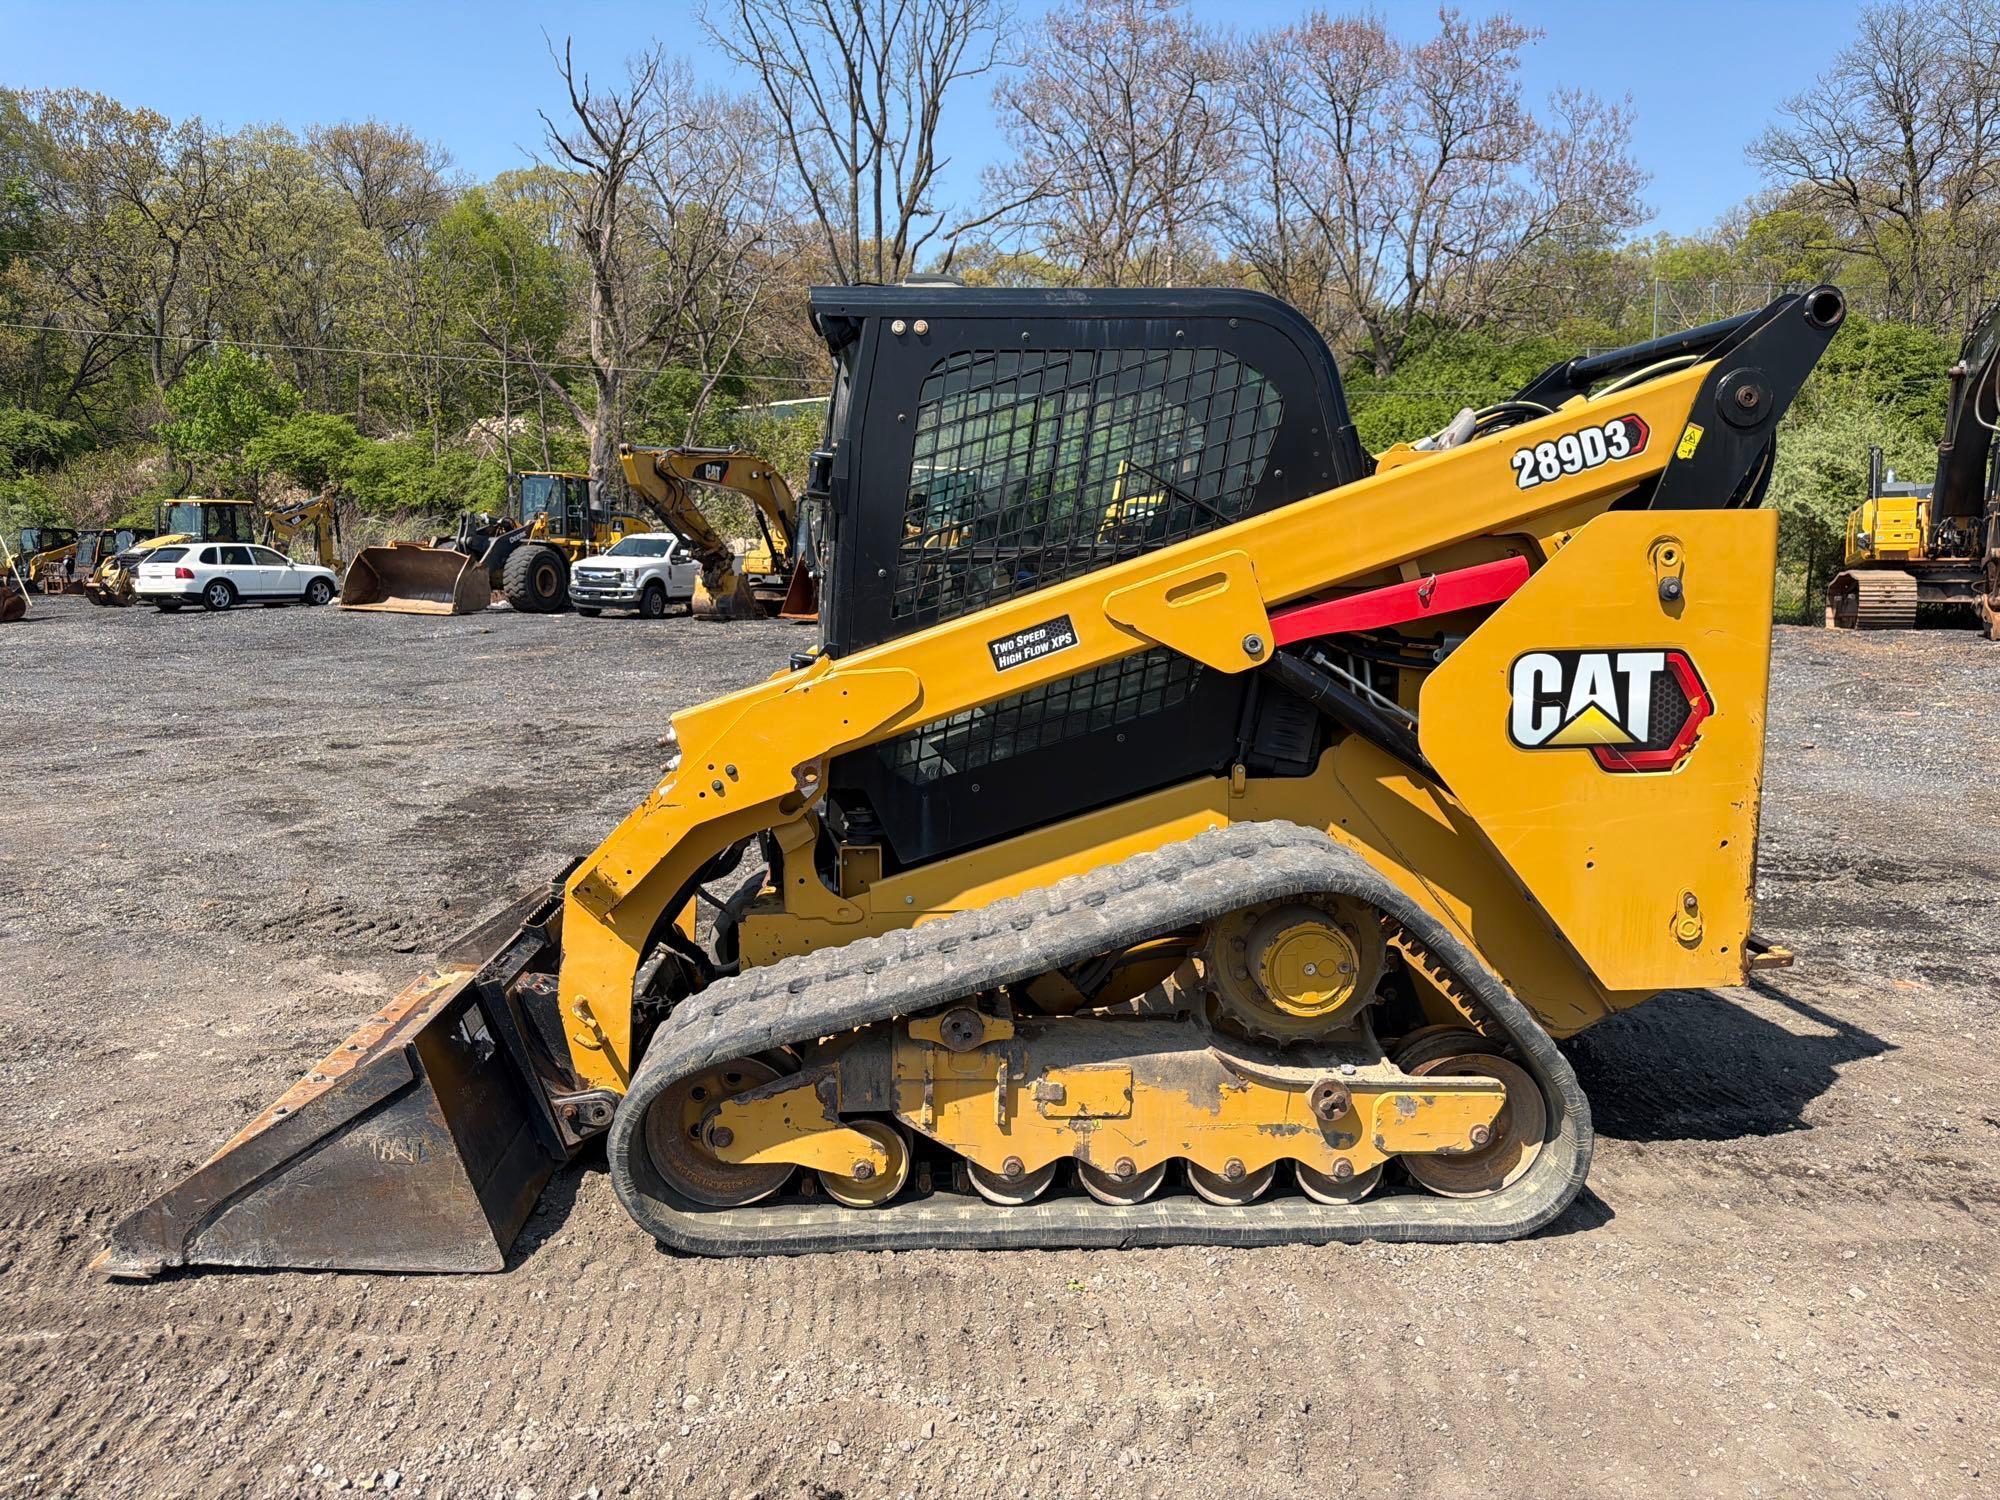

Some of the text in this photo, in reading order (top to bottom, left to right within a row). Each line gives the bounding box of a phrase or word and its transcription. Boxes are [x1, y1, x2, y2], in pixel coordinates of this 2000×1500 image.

[705, 463, 721, 481] CAT
[1512, 420, 1630, 489] 289D3
[1051, 633, 1072, 649] XPS
[1512, 652, 1665, 745] CAT
